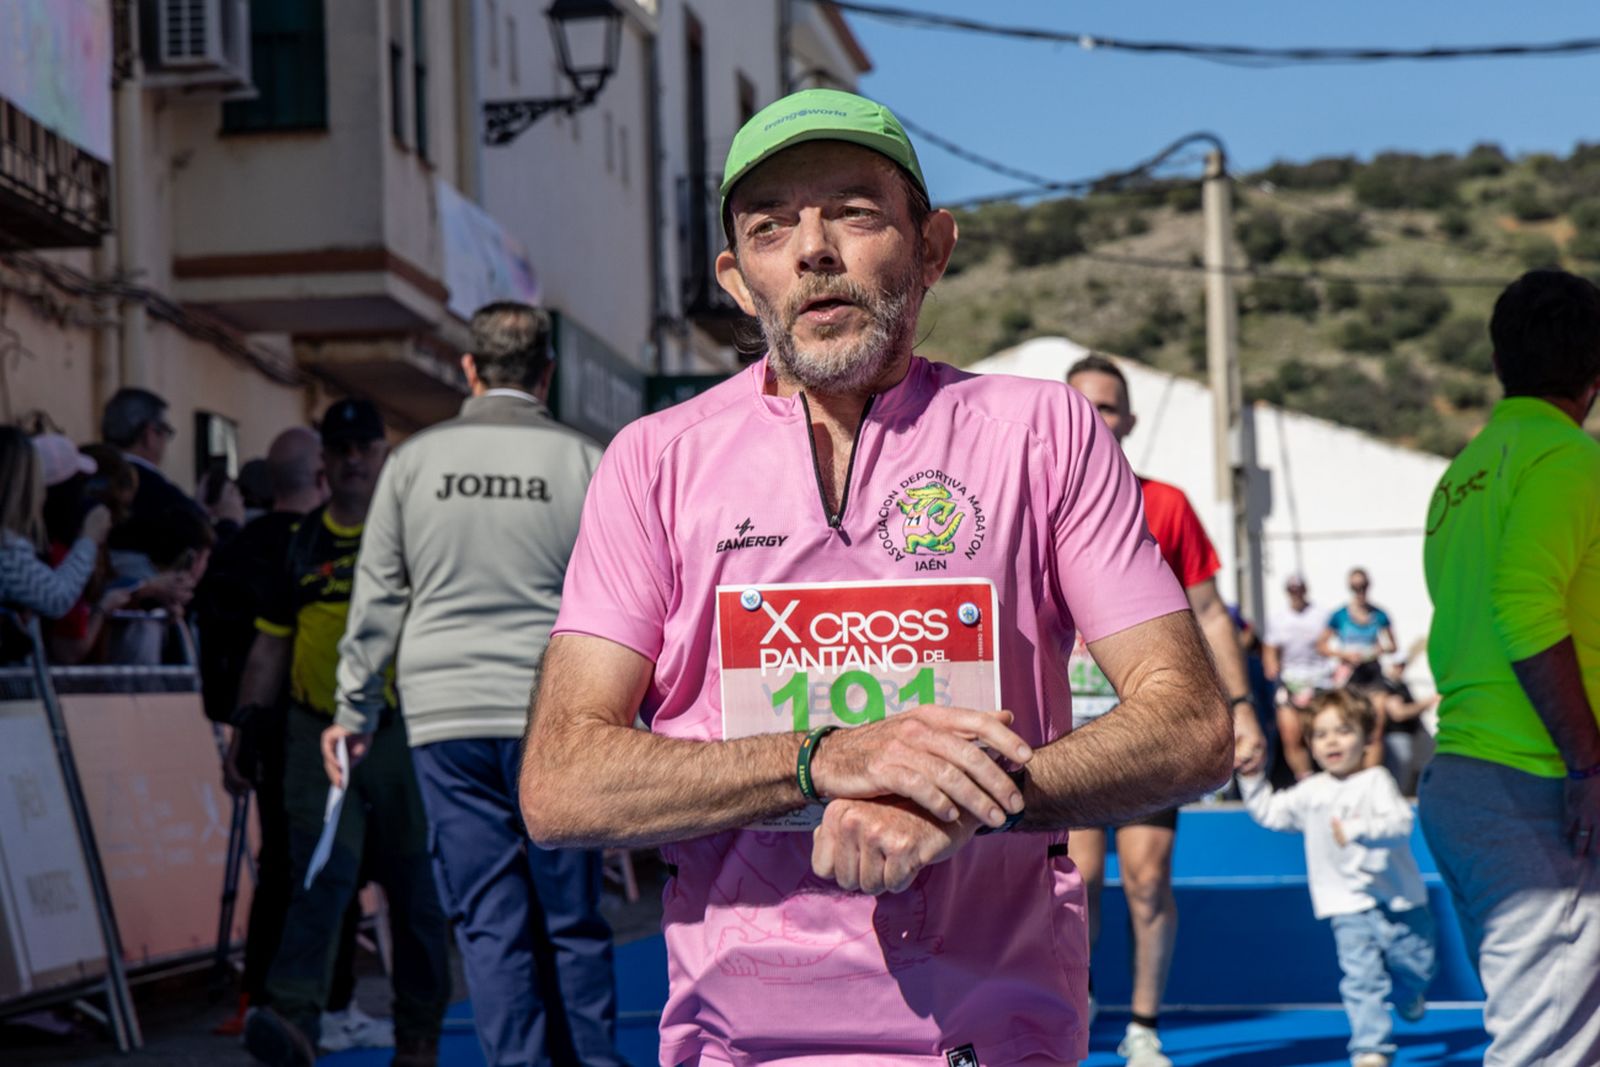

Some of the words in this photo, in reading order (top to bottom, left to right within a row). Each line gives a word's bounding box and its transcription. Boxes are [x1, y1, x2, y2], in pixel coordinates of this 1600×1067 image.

[877, 489, 906, 562] ASOCIACION
[899, 468, 968, 496] DEPORTIVA
[964, 494, 986, 561] MARATON
[715, 535, 789, 553] EAMERGY
[915, 558, 947, 571] JAÉN
[760, 599, 801, 645] X
[809, 609, 950, 645] CROSS
[759, 643, 918, 677] PANTANO
[923, 650, 951, 663] DEL
